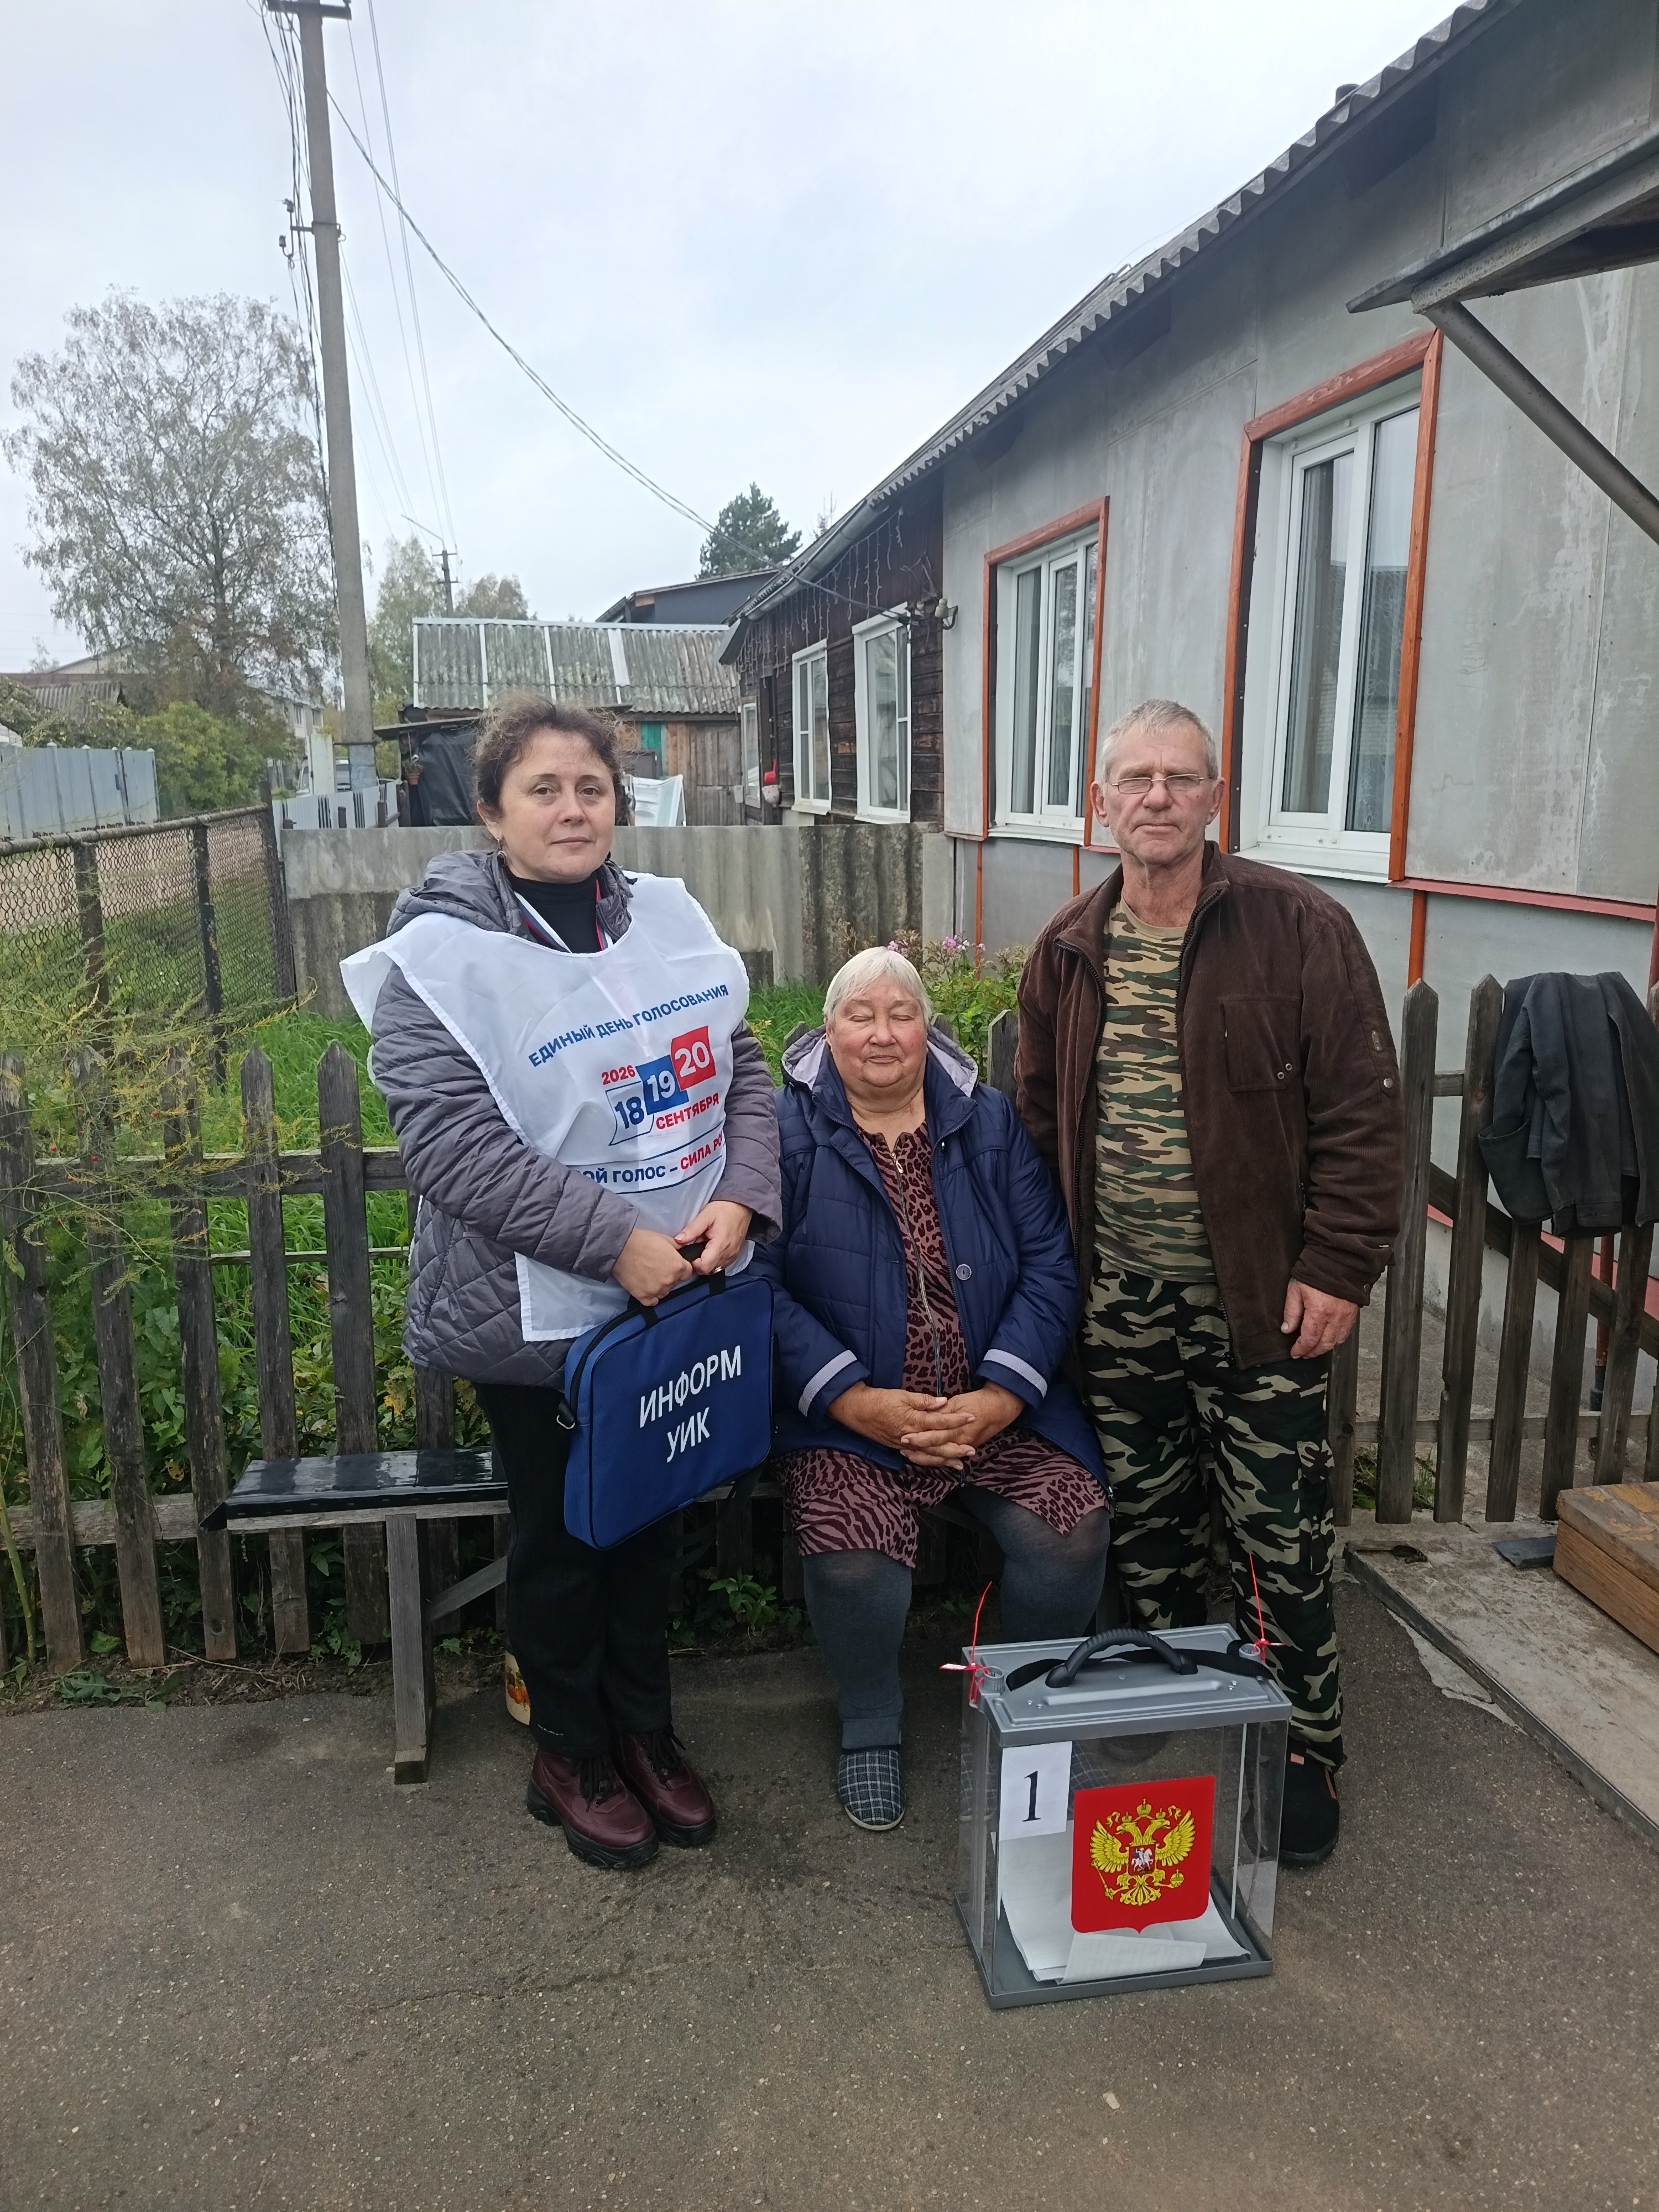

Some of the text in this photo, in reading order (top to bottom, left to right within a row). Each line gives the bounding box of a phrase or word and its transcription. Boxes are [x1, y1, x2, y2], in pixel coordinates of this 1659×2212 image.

[528, 984, 729, 1067] ЕДИНЫЙ ДЕНЬ ГОЛОСОВАНИЯ
[601, 1065, 636, 1086] 2026
[614, 1041, 710, 1129] 18 19 20
[656, 1093, 719, 1130] СЕНТЯБРЯ
[576, 1167, 608, 1183] ОЙ
[613, 1166, 666, 1183] ГОЛОС
[680, 1144, 712, 1170] СИЛА
[713, 1130, 723, 1151] РО
[639, 1345, 741, 1428] ИНФОРМ
[666, 1407, 710, 1463] УИК
[1021, 1771, 1042, 1823] 1
